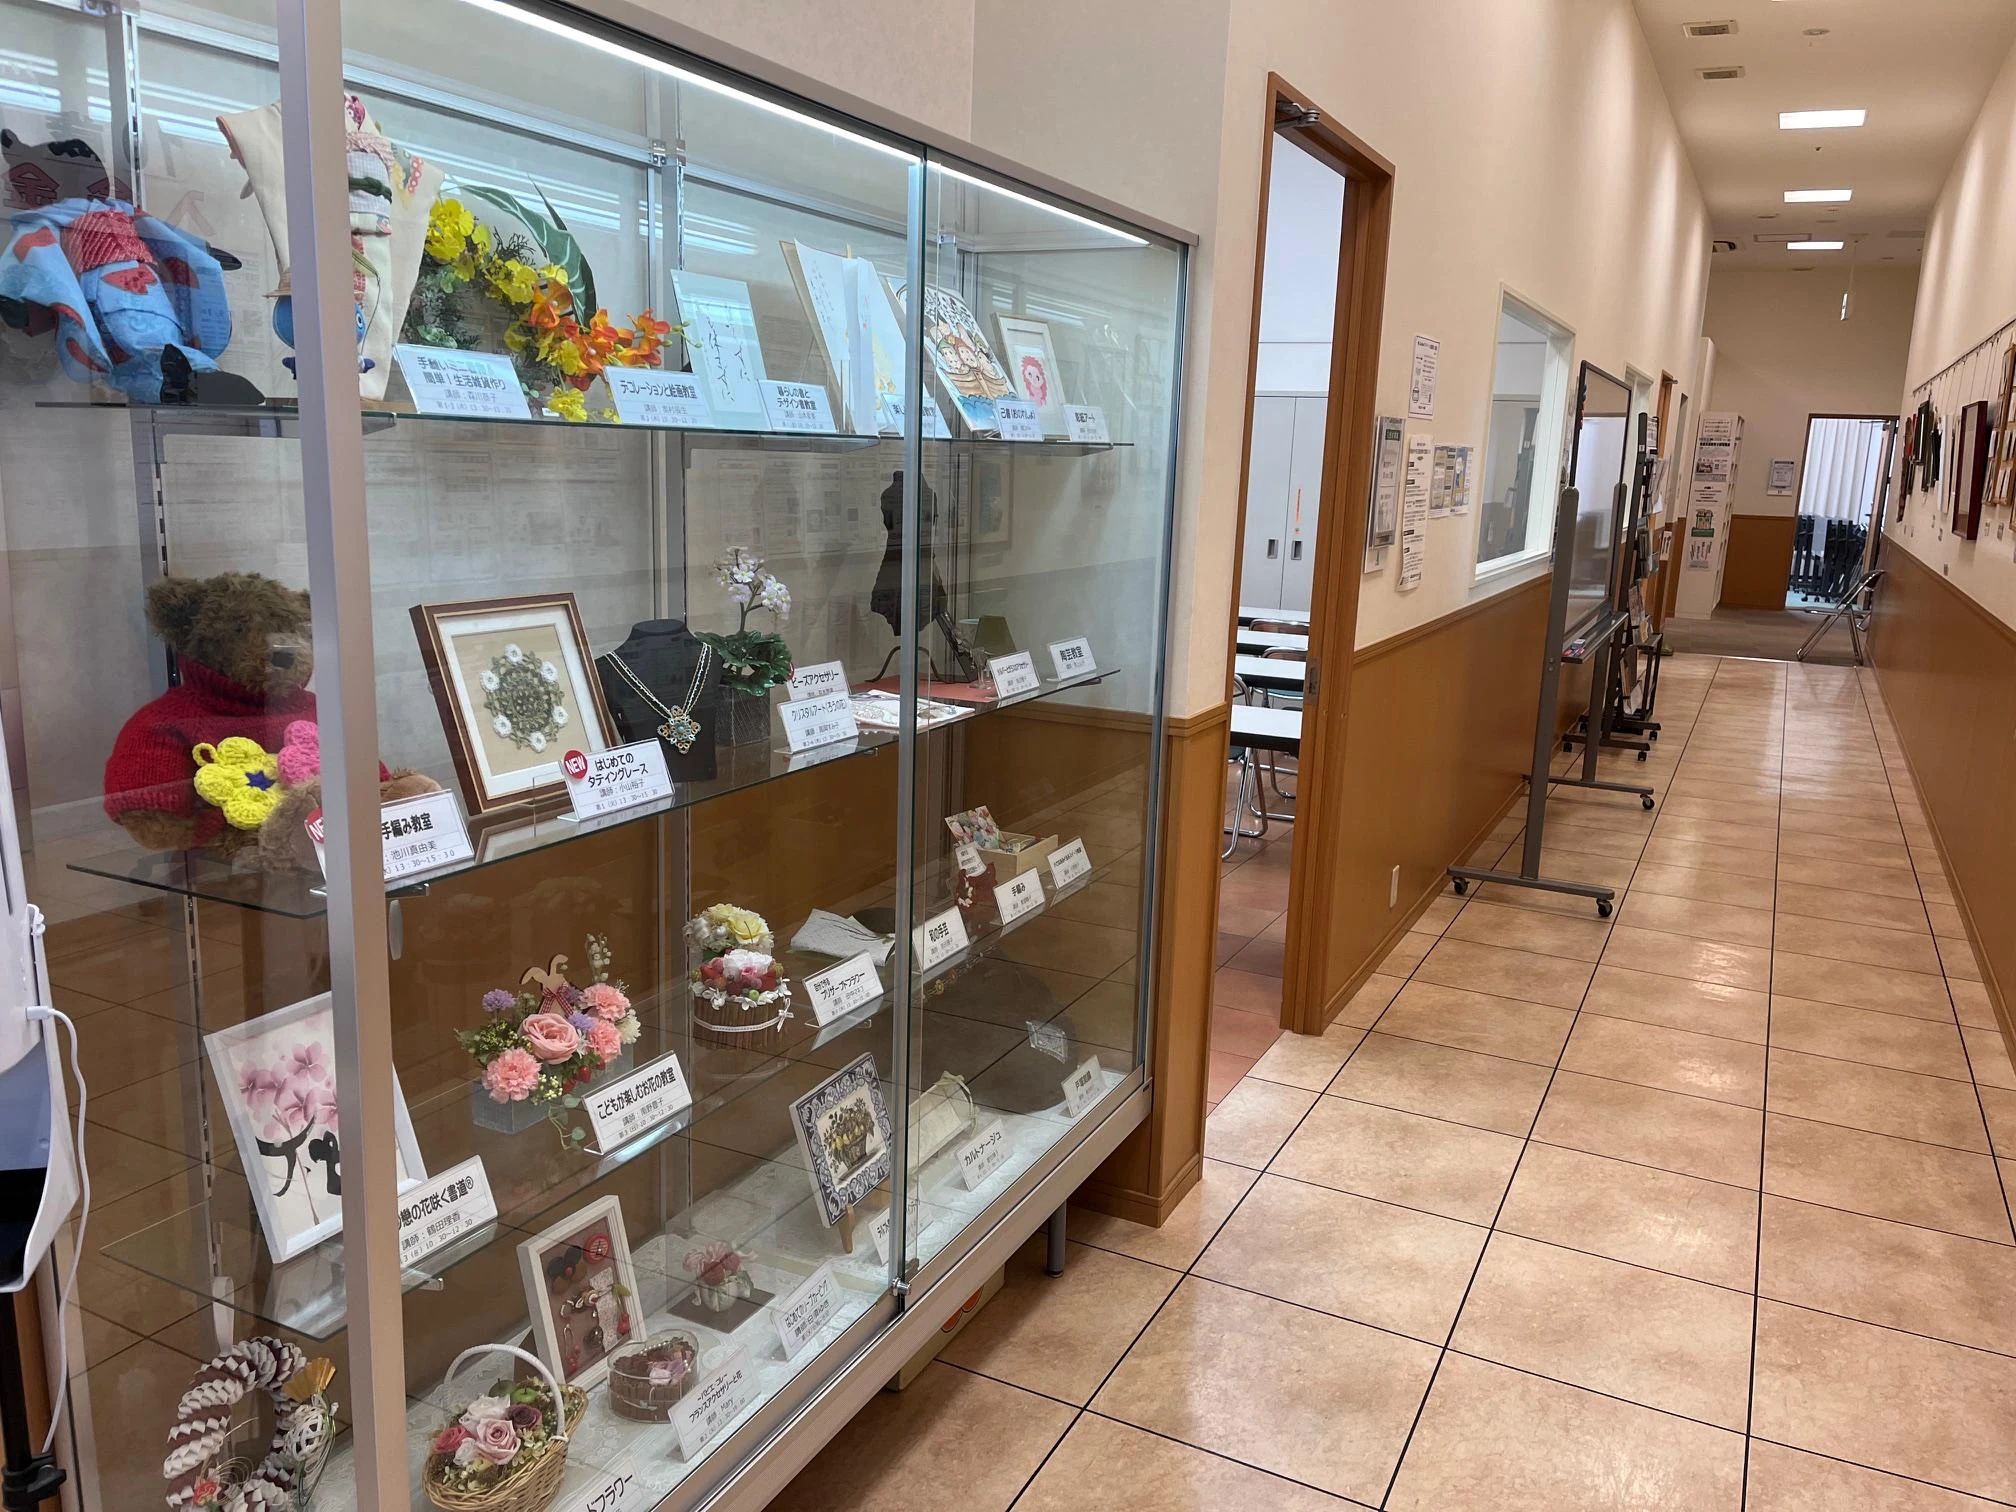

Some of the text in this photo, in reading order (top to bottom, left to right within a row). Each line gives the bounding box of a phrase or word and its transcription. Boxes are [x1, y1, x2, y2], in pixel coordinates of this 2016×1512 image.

[618, 379, 699, 400] デコレーションと絵画教室
[1060, 646, 1085, 663] 陶芸教室
[792, 671, 840, 688] ビーズアクセサリー
[566, 756, 585, 774] NEW
[594, 751, 636, 772] はじめての
[586, 761, 650, 789] タティングレース
[381, 814, 433, 840] 手編み教室
[1011, 883, 1026, 897] 手編み
[597, 1067, 676, 1120] こどもが楽しむお花の教室
[965, 1132, 1002, 1166] カルトナージュ
[689, 1372, 743, 1423] フランスアクセサリーと花
